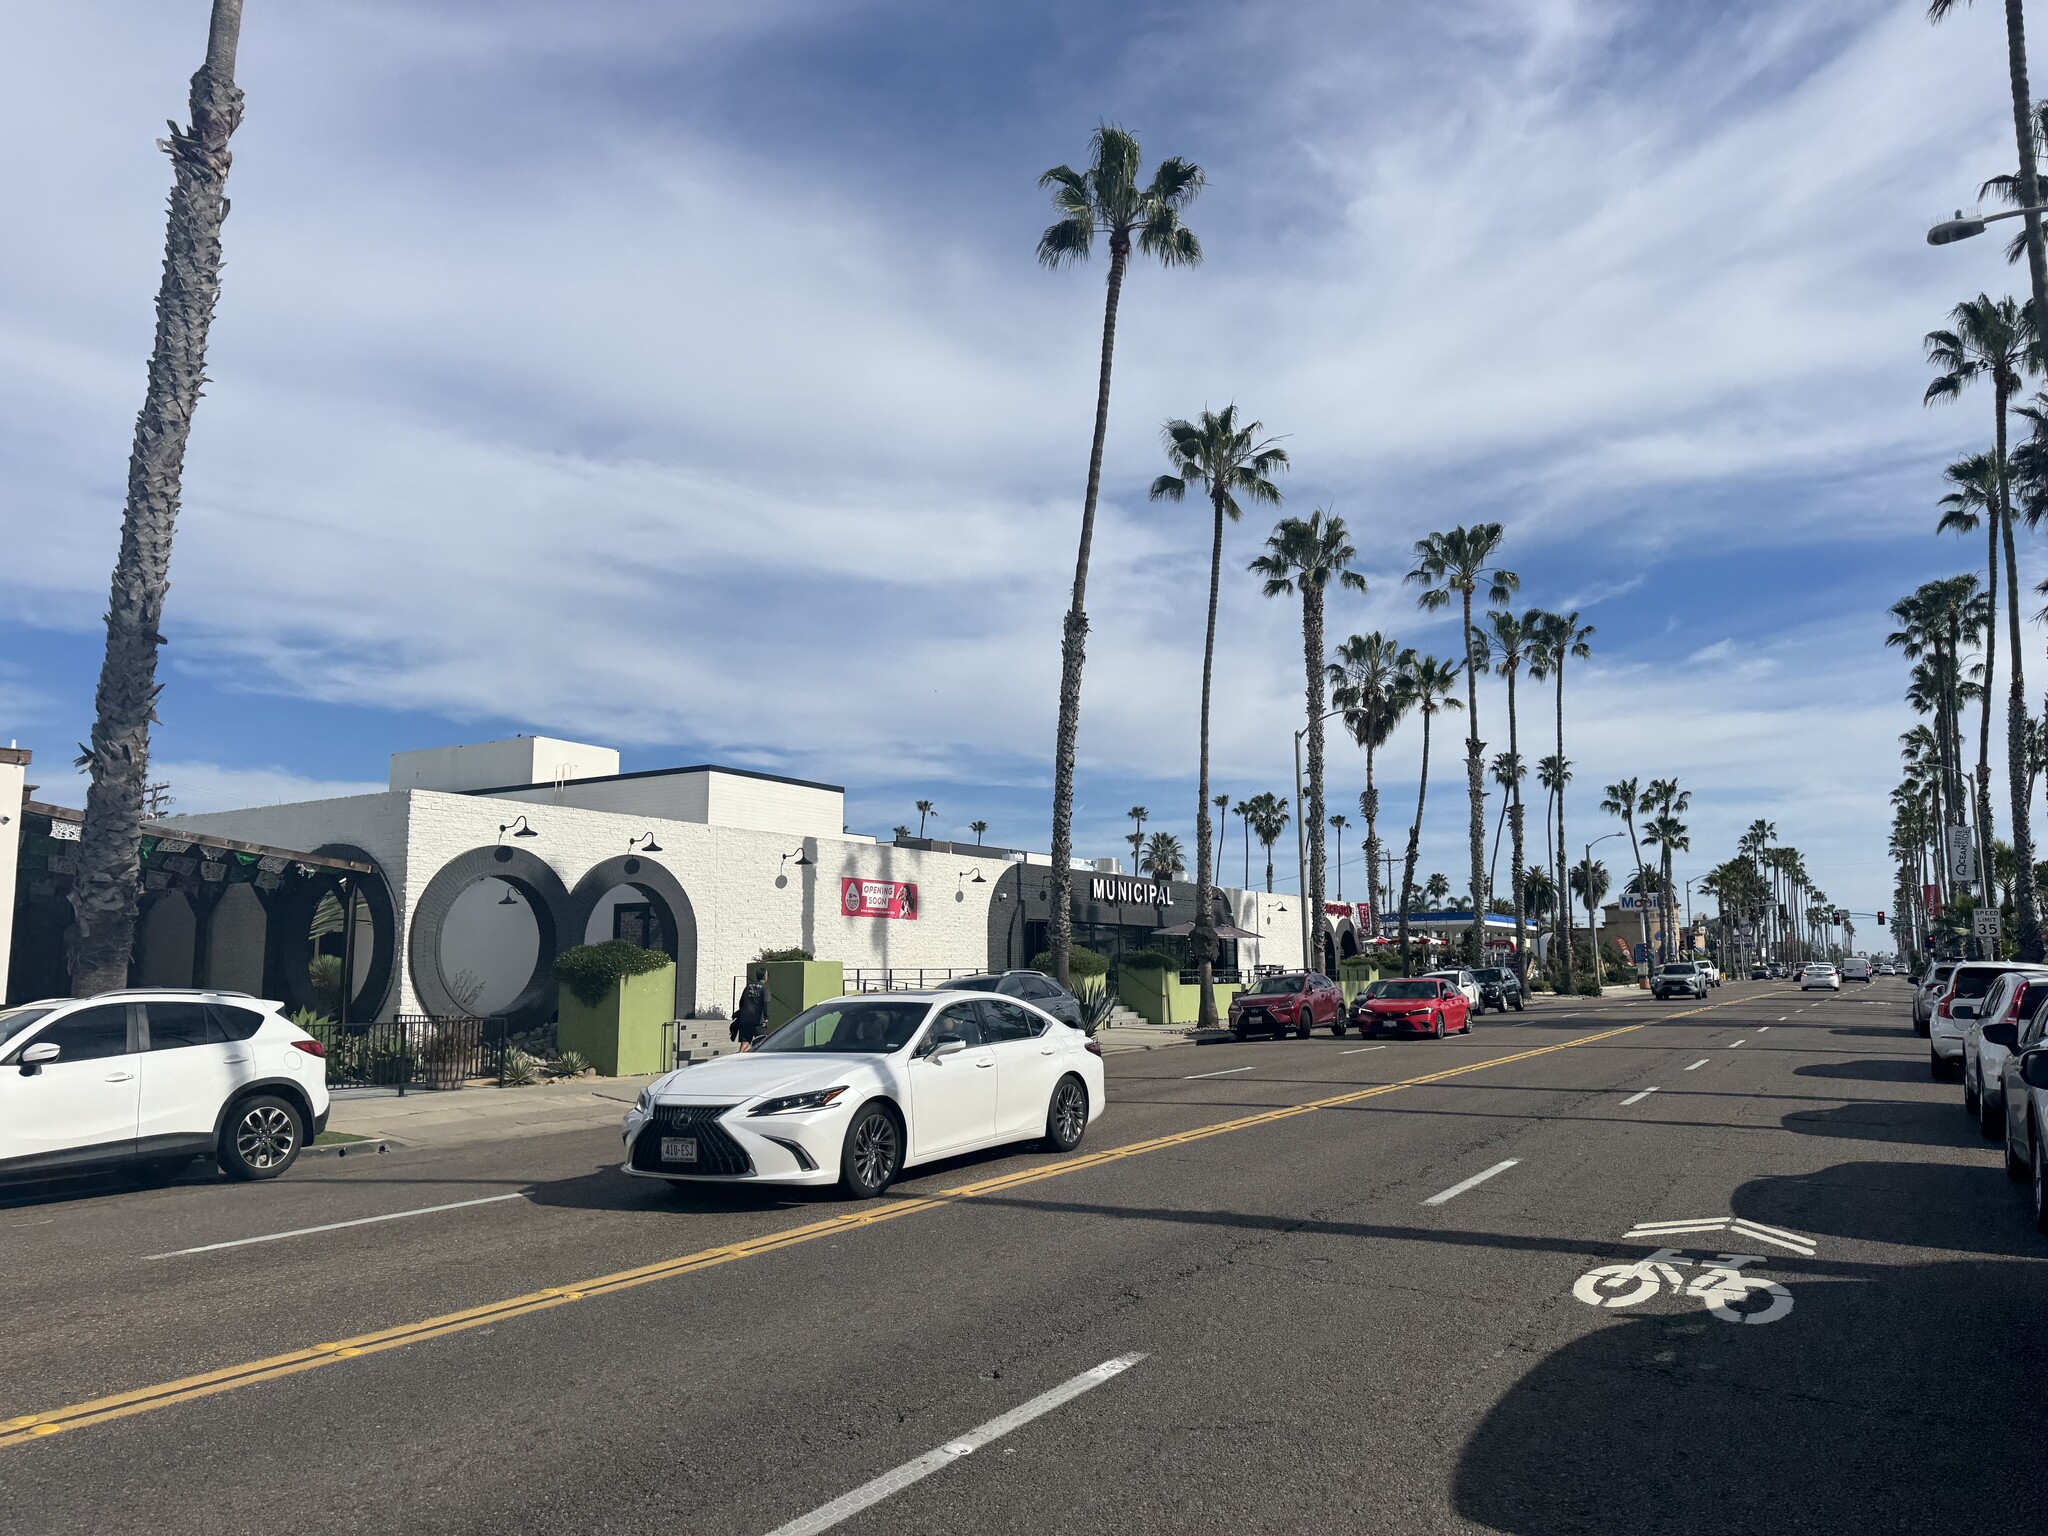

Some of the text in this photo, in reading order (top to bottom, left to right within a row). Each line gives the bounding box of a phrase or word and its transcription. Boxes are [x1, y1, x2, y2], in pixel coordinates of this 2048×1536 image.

[1955, 829, 1971, 876] OCEANSIDE
[863, 885, 893, 895] OPENING
[1092, 878, 1174, 905] MUNICIPAL
[868, 896, 887, 905] SOON
[1978, 923, 1998, 935] 35
